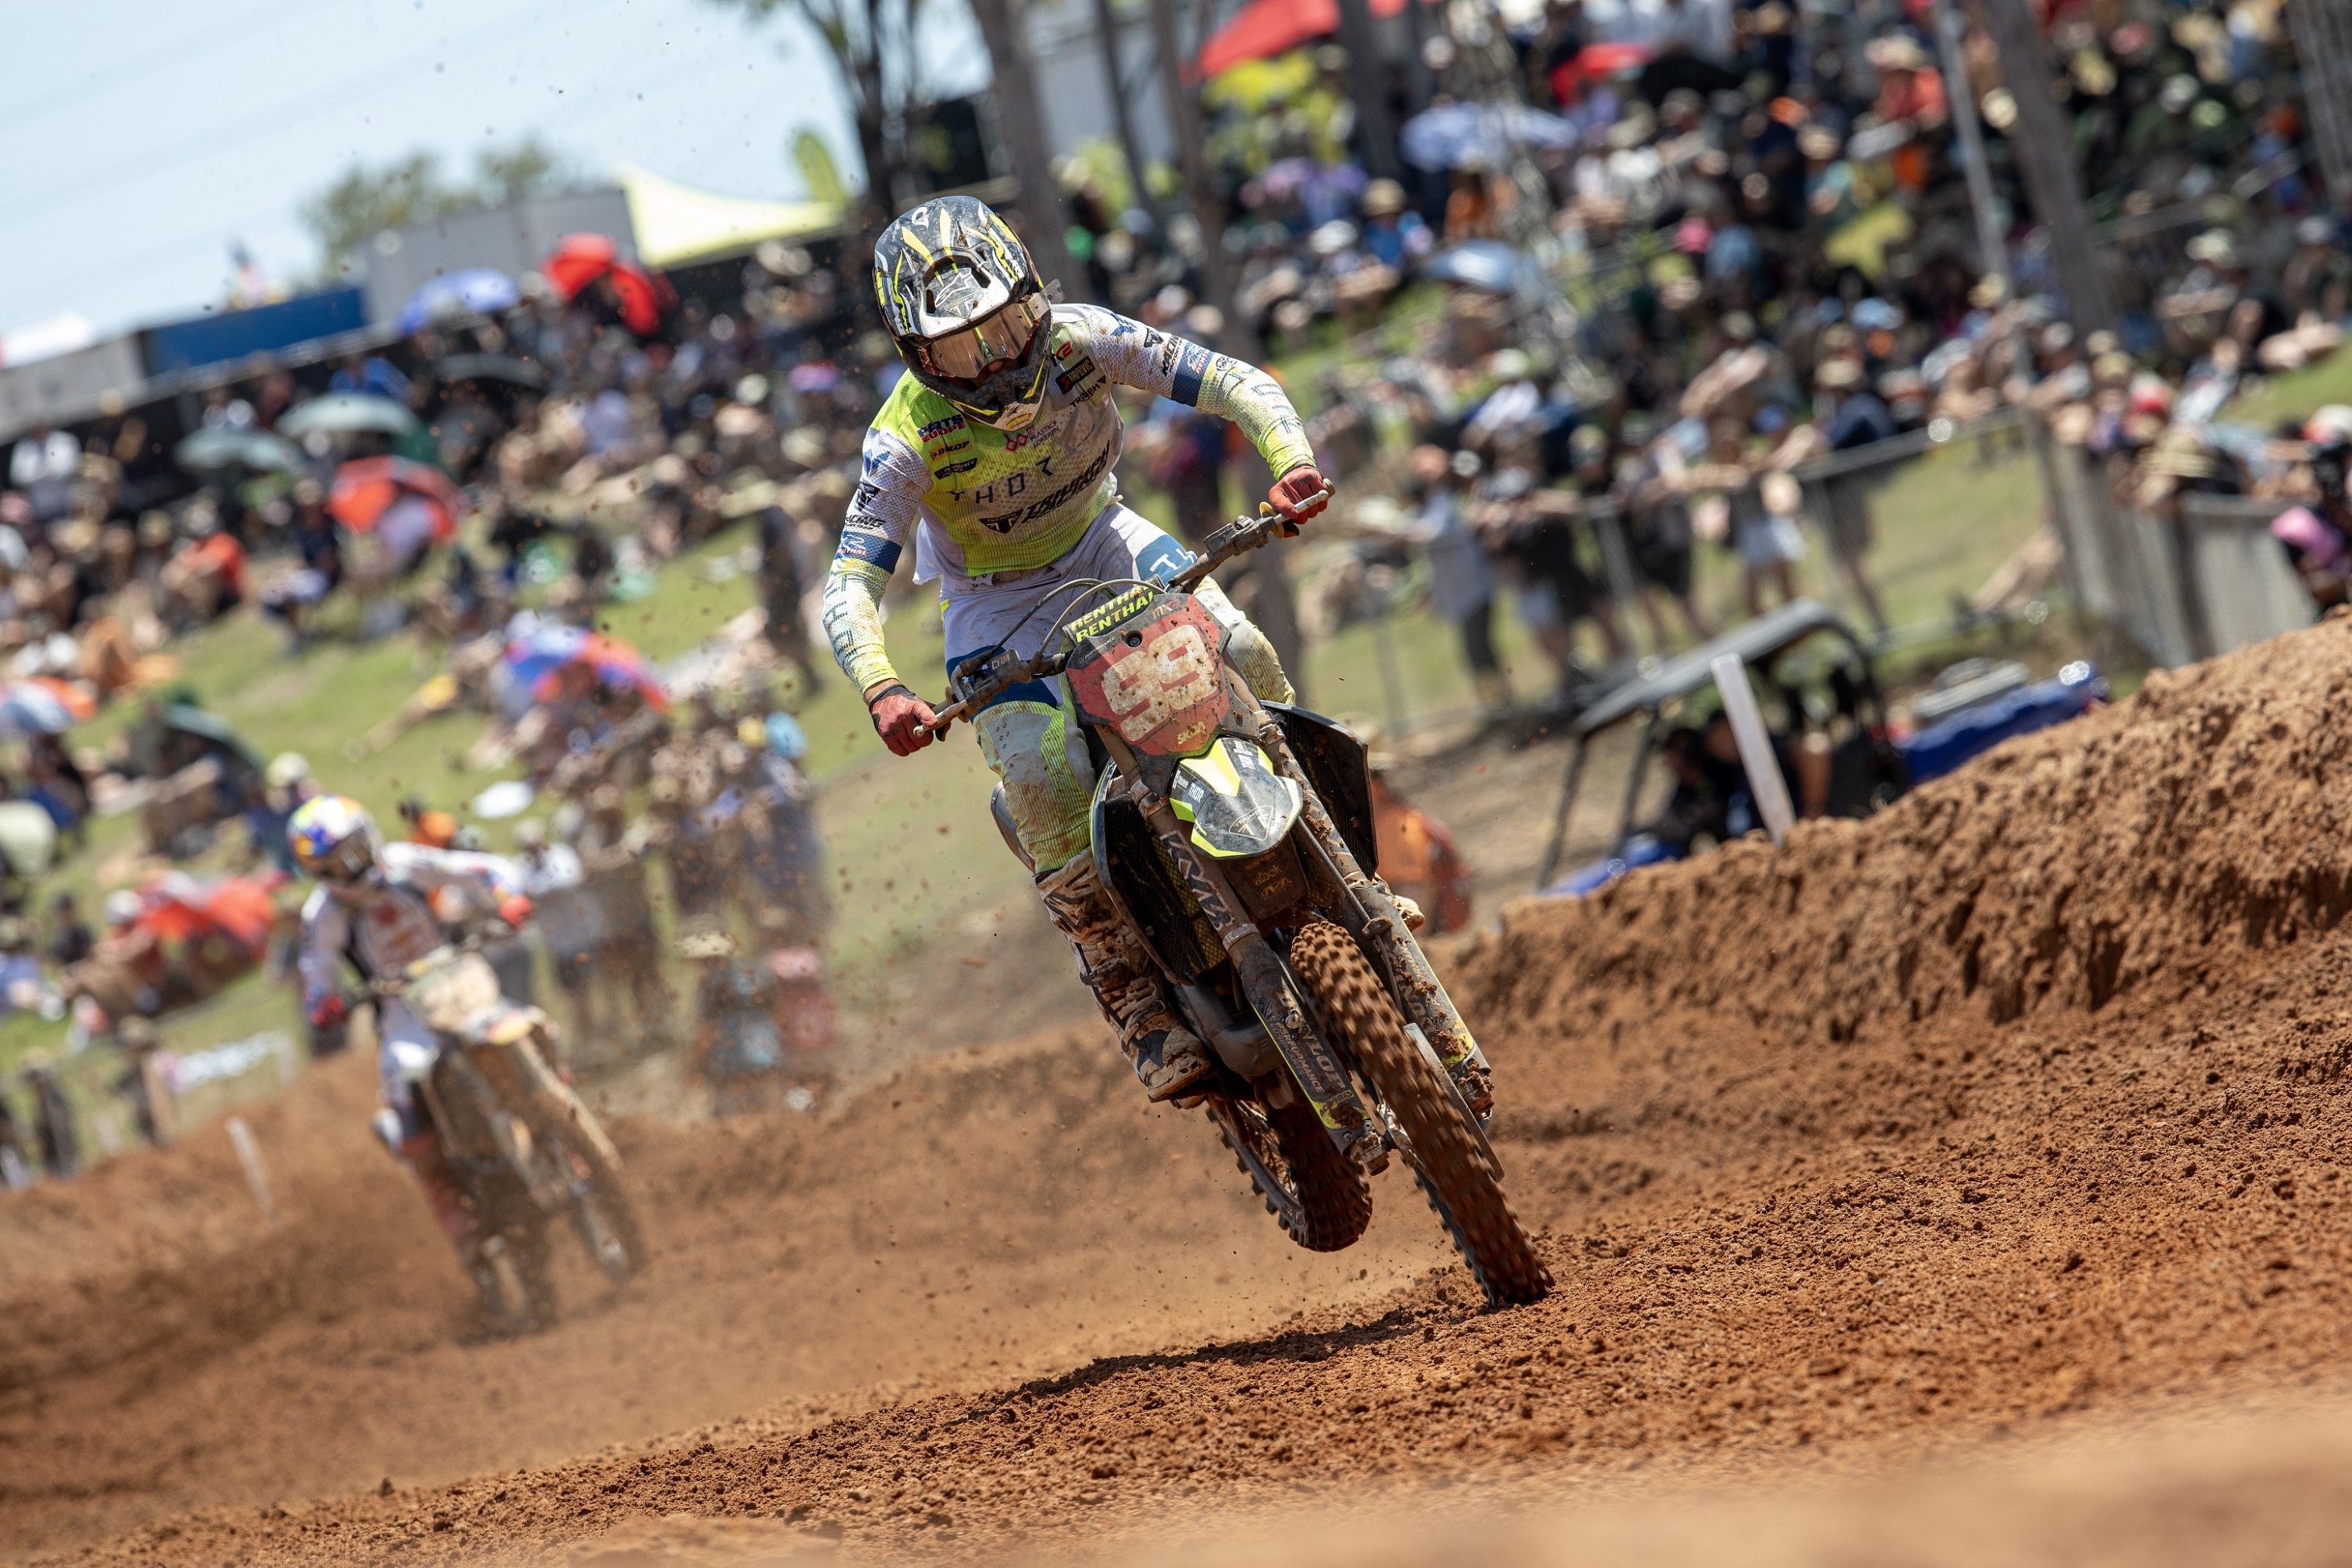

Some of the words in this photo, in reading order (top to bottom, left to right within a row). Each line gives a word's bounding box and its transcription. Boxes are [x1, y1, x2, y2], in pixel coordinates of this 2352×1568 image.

[917, 413, 965, 438] PARTS
[1070, 585, 1149, 631] RENTHA
[1101, 624, 1218, 742] 99
[1188, 780, 1205, 804] THOR
[1276, 1020, 1323, 1094] PERFORMANCE
